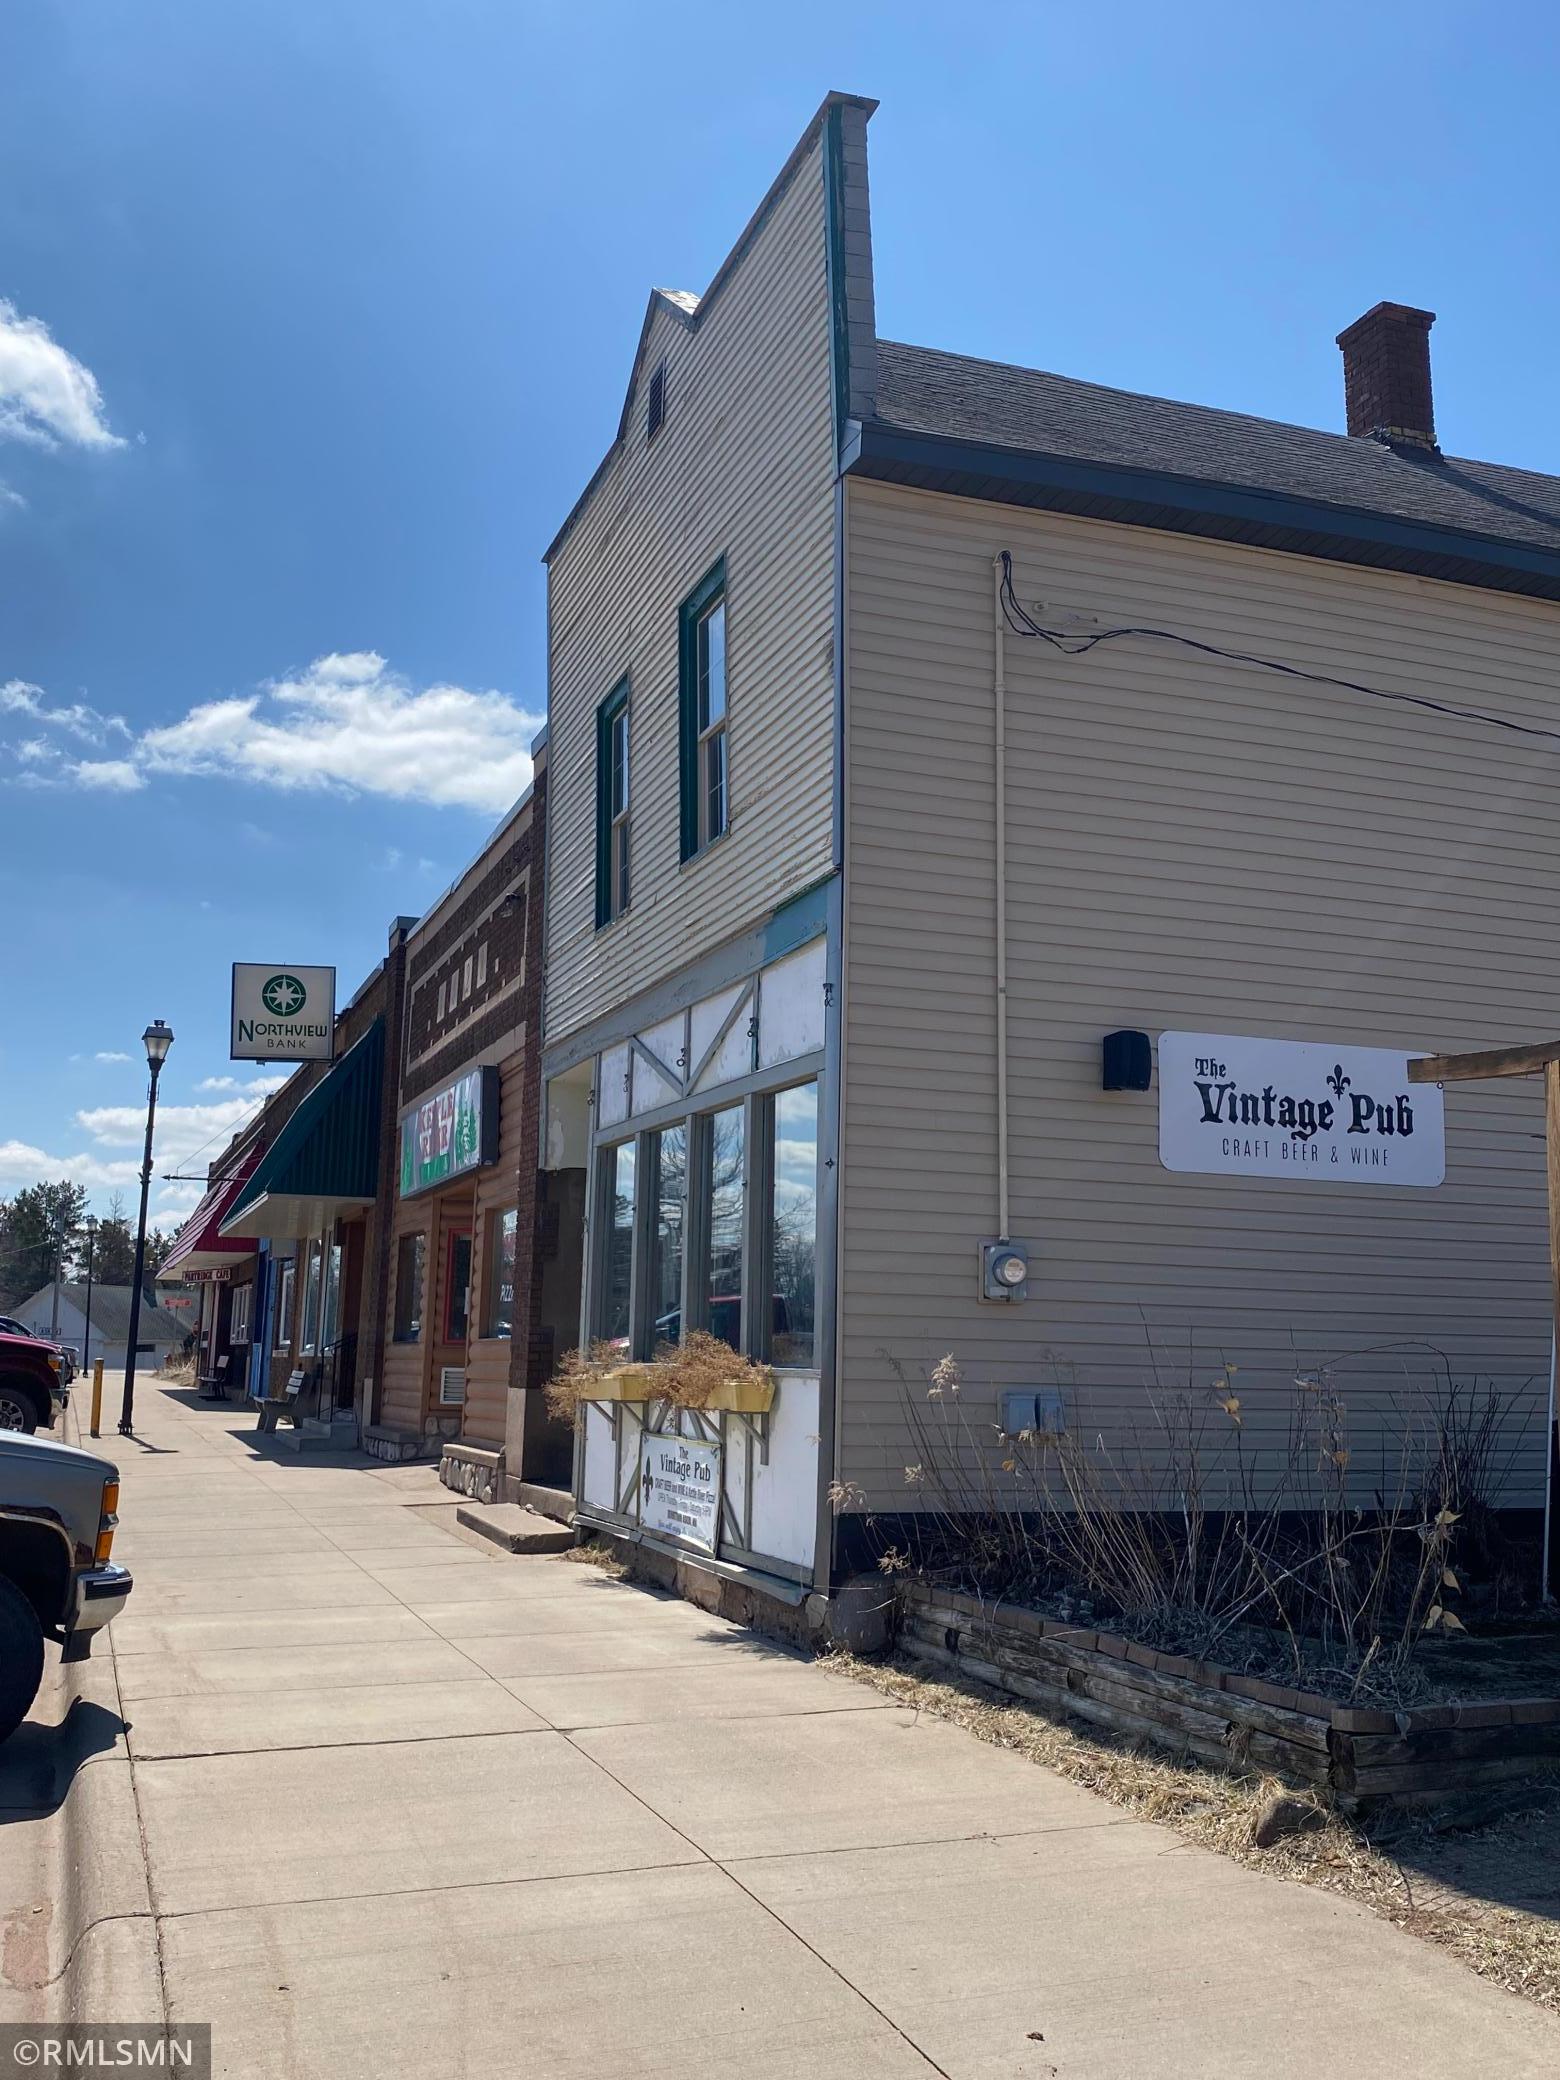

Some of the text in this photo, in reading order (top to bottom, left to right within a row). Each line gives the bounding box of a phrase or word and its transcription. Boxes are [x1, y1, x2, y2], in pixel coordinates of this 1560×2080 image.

[238, 1019, 328, 1042] NORTHVIEW
[267, 1039, 306, 1049] BANK
[1194, 1057, 1227, 1080] The
[1193, 1080, 1414, 1141] Vintage Pub
[1222, 1138, 1389, 1167] CRAFT BEER & WINE
[680, 1446, 689, 1460] The
[660, 1453, 711, 1481] Vintage Pub
